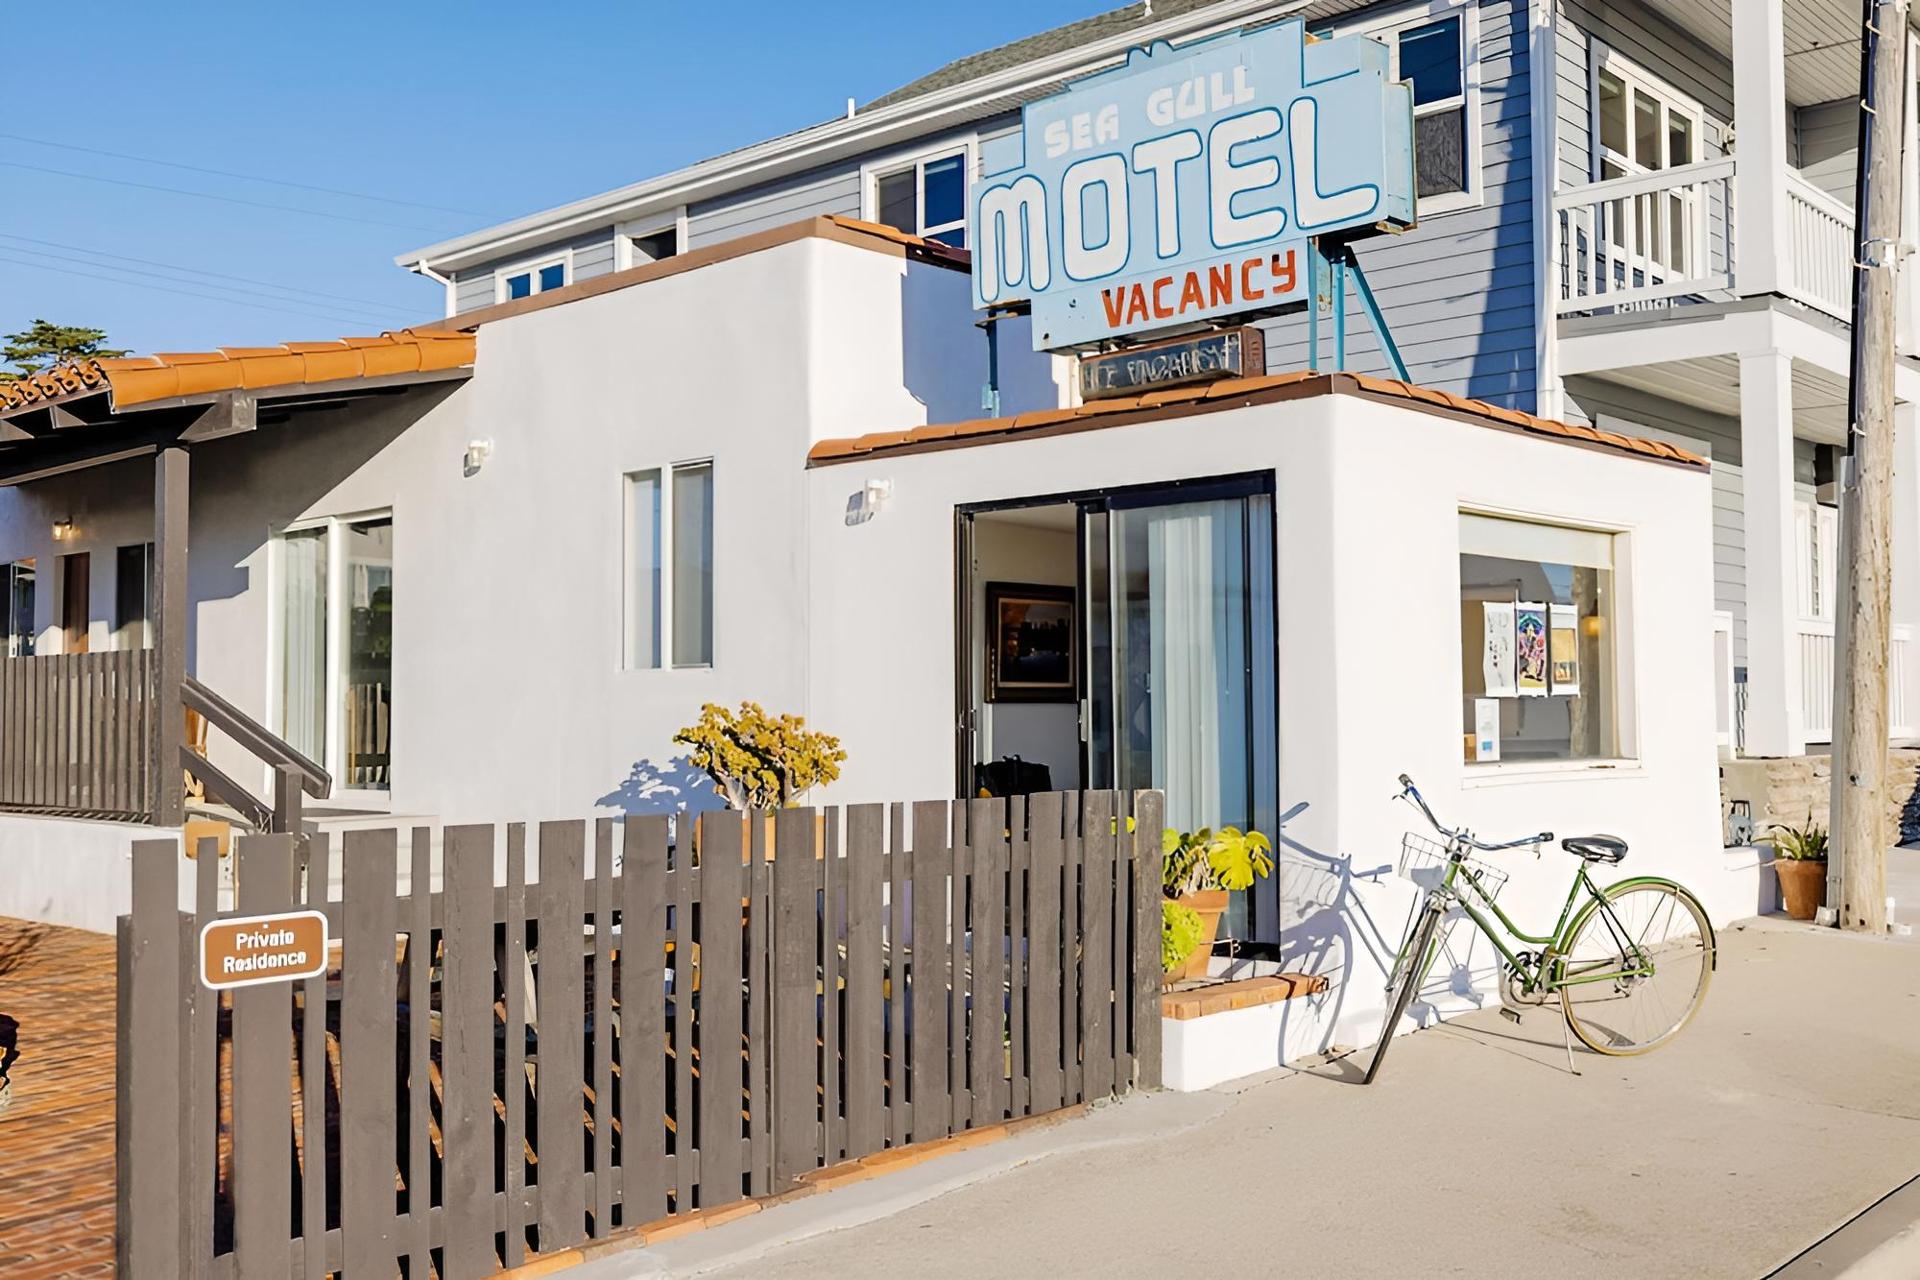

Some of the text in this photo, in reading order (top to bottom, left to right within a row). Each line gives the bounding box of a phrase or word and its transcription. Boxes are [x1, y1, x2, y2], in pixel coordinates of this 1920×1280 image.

[1044, 65, 1255, 158] SEA GULL
[979, 96, 1379, 302] MOTEL
[1101, 250, 1297, 328] VACANCY
[223, 951, 307, 974] Residence
[236, 929, 295, 951] Private
